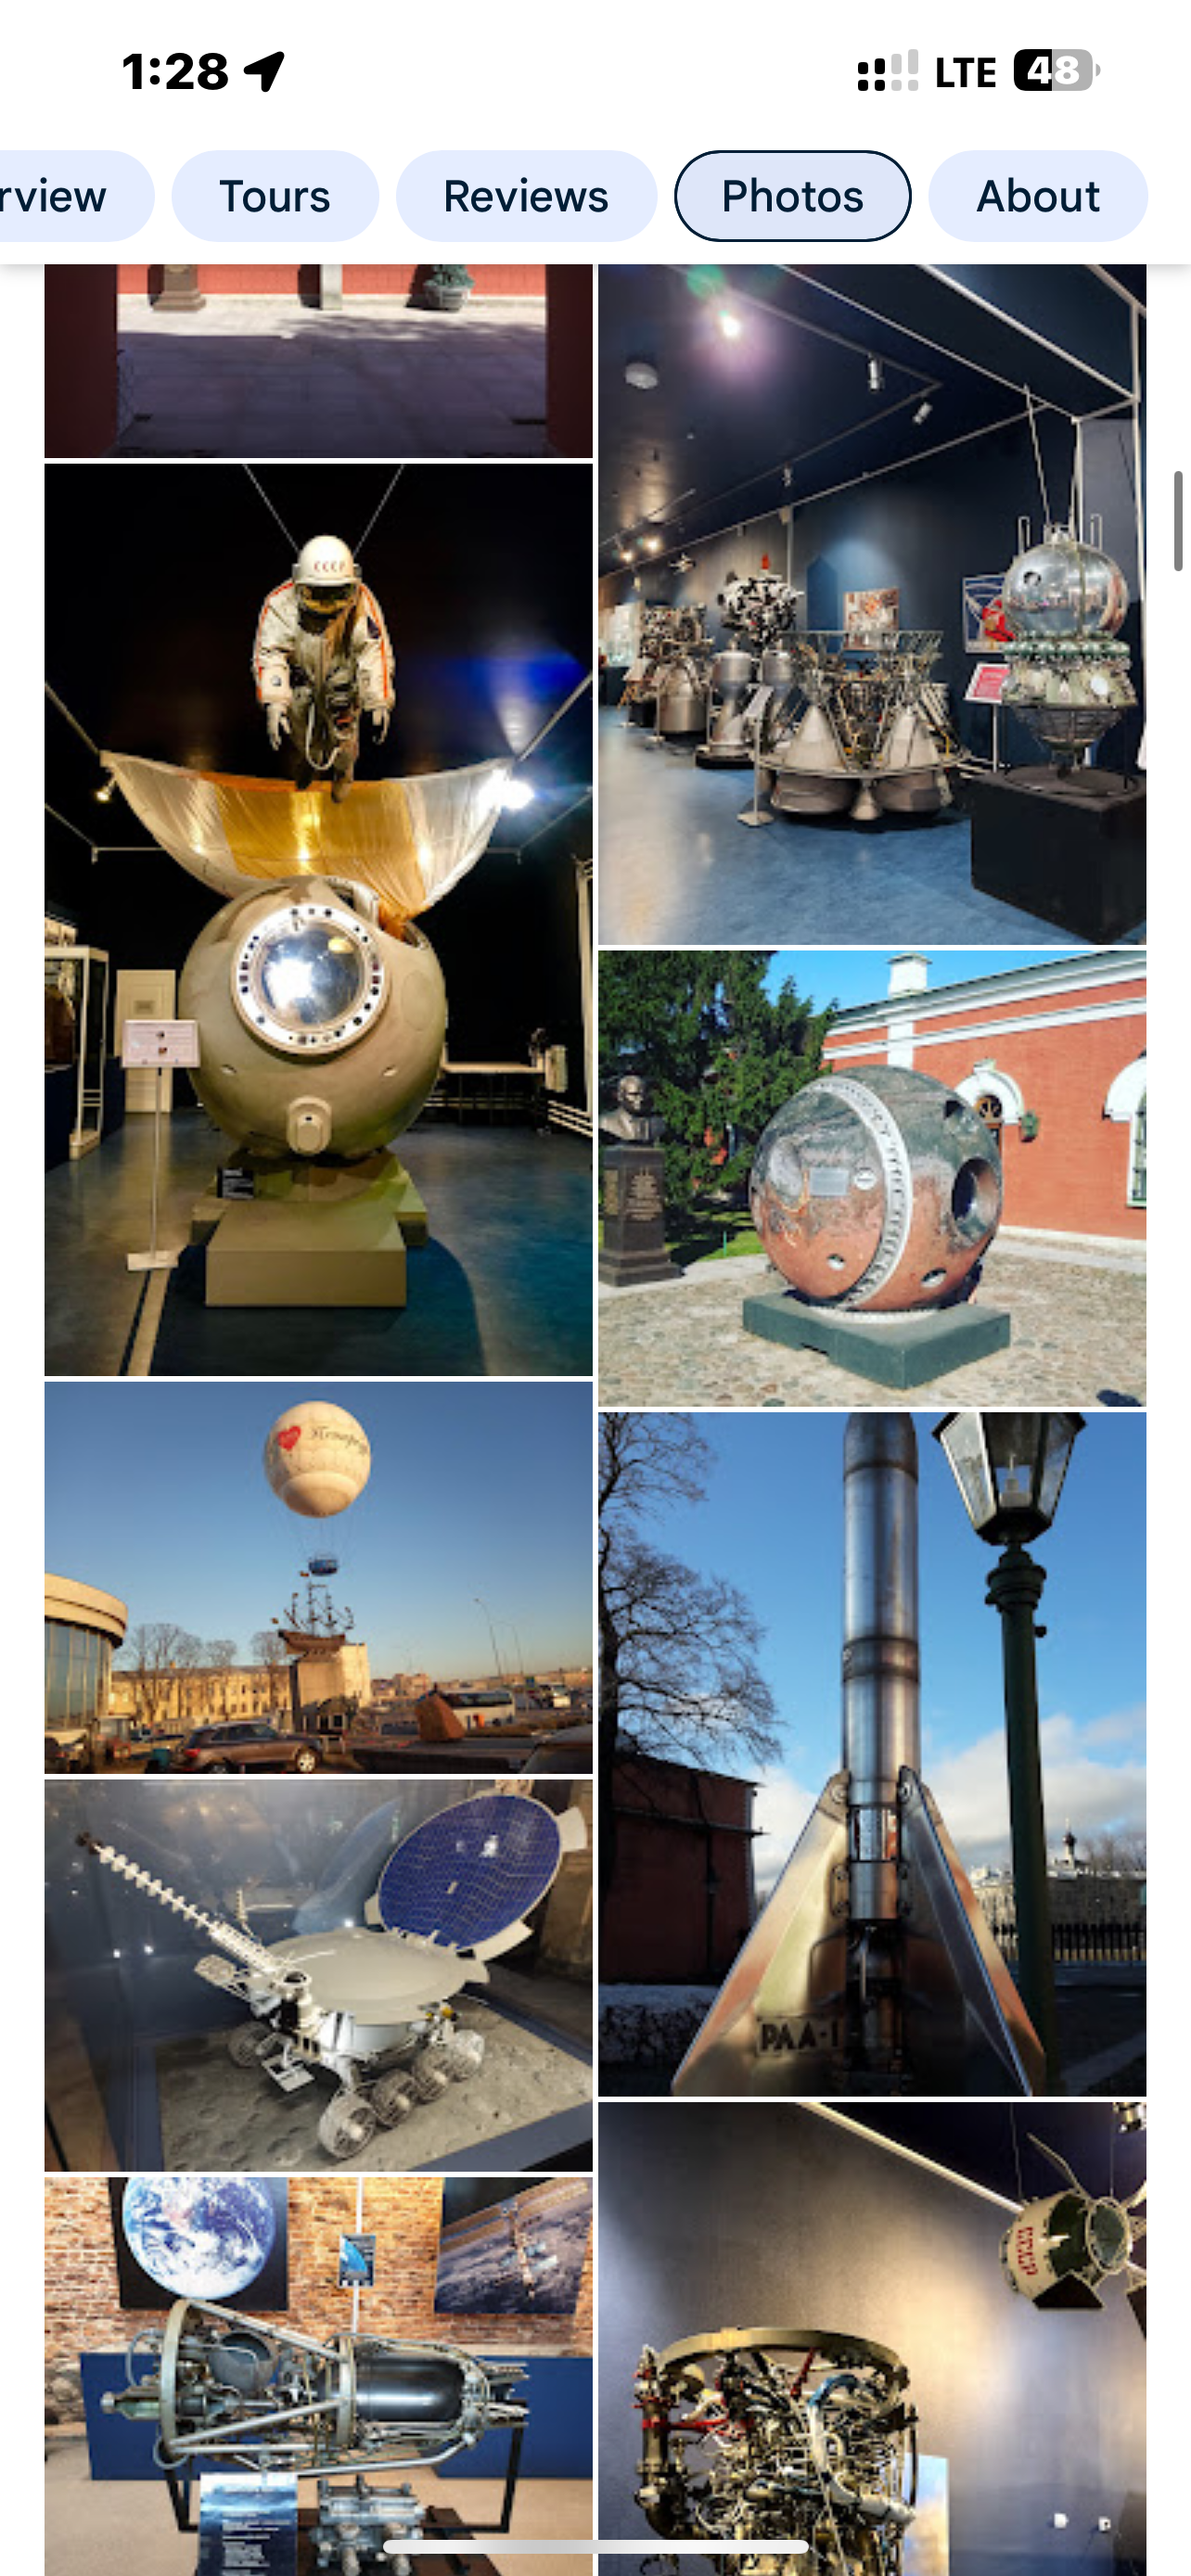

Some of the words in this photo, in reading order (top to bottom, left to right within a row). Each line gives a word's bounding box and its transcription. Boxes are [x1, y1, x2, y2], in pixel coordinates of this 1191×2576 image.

[122, 52, 229, 91] 1:28
[936, 57, 996, 88] LTE
[1027, 55, 1080, 85] 48
[219, 179, 330, 213] Tours
[445, 176, 608, 213] Reviews
[724, 176, 864, 213] Photos
[976, 177, 1100, 213] About
